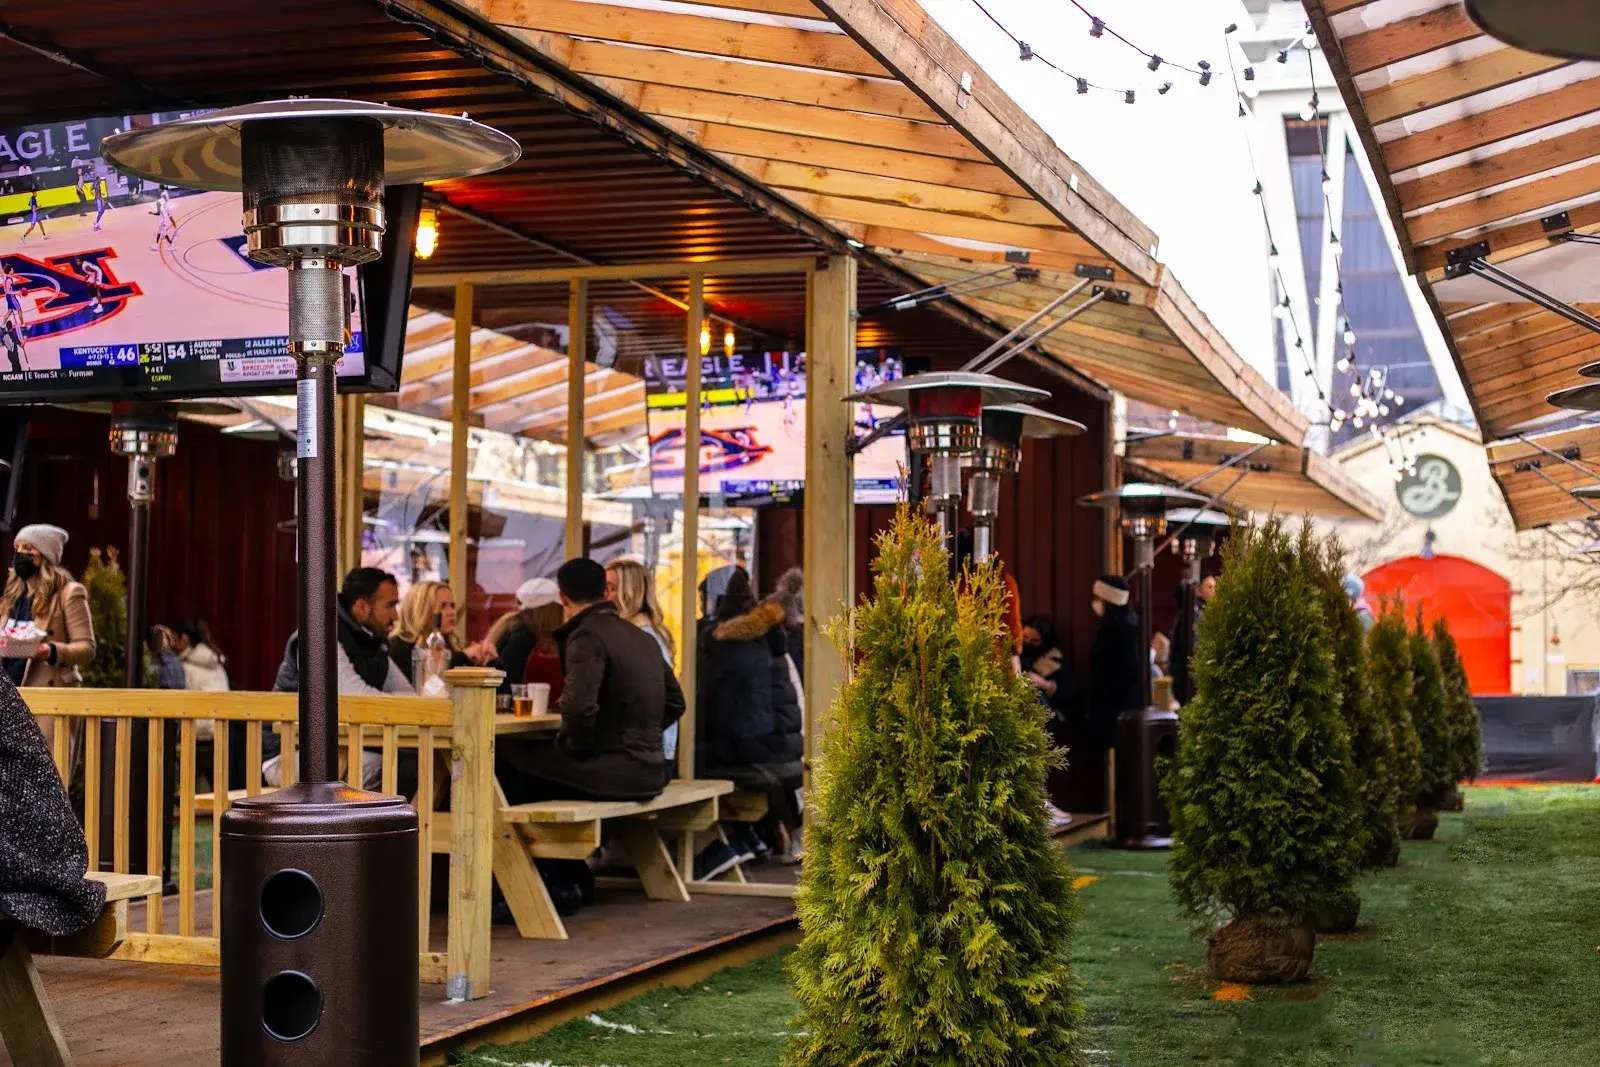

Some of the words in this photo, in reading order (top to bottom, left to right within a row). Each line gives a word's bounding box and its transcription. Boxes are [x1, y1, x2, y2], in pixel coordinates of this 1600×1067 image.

[253, 339, 276, 348] ALLEN
[73, 347, 108, 355] KENTUCKY
[117, 347, 136, 362] 46
[144, 343, 162, 353] 5:52
[167, 344, 186, 360] 54
[34, 371, 49, 379] Tenn
[69, 370, 94, 378] Furman
